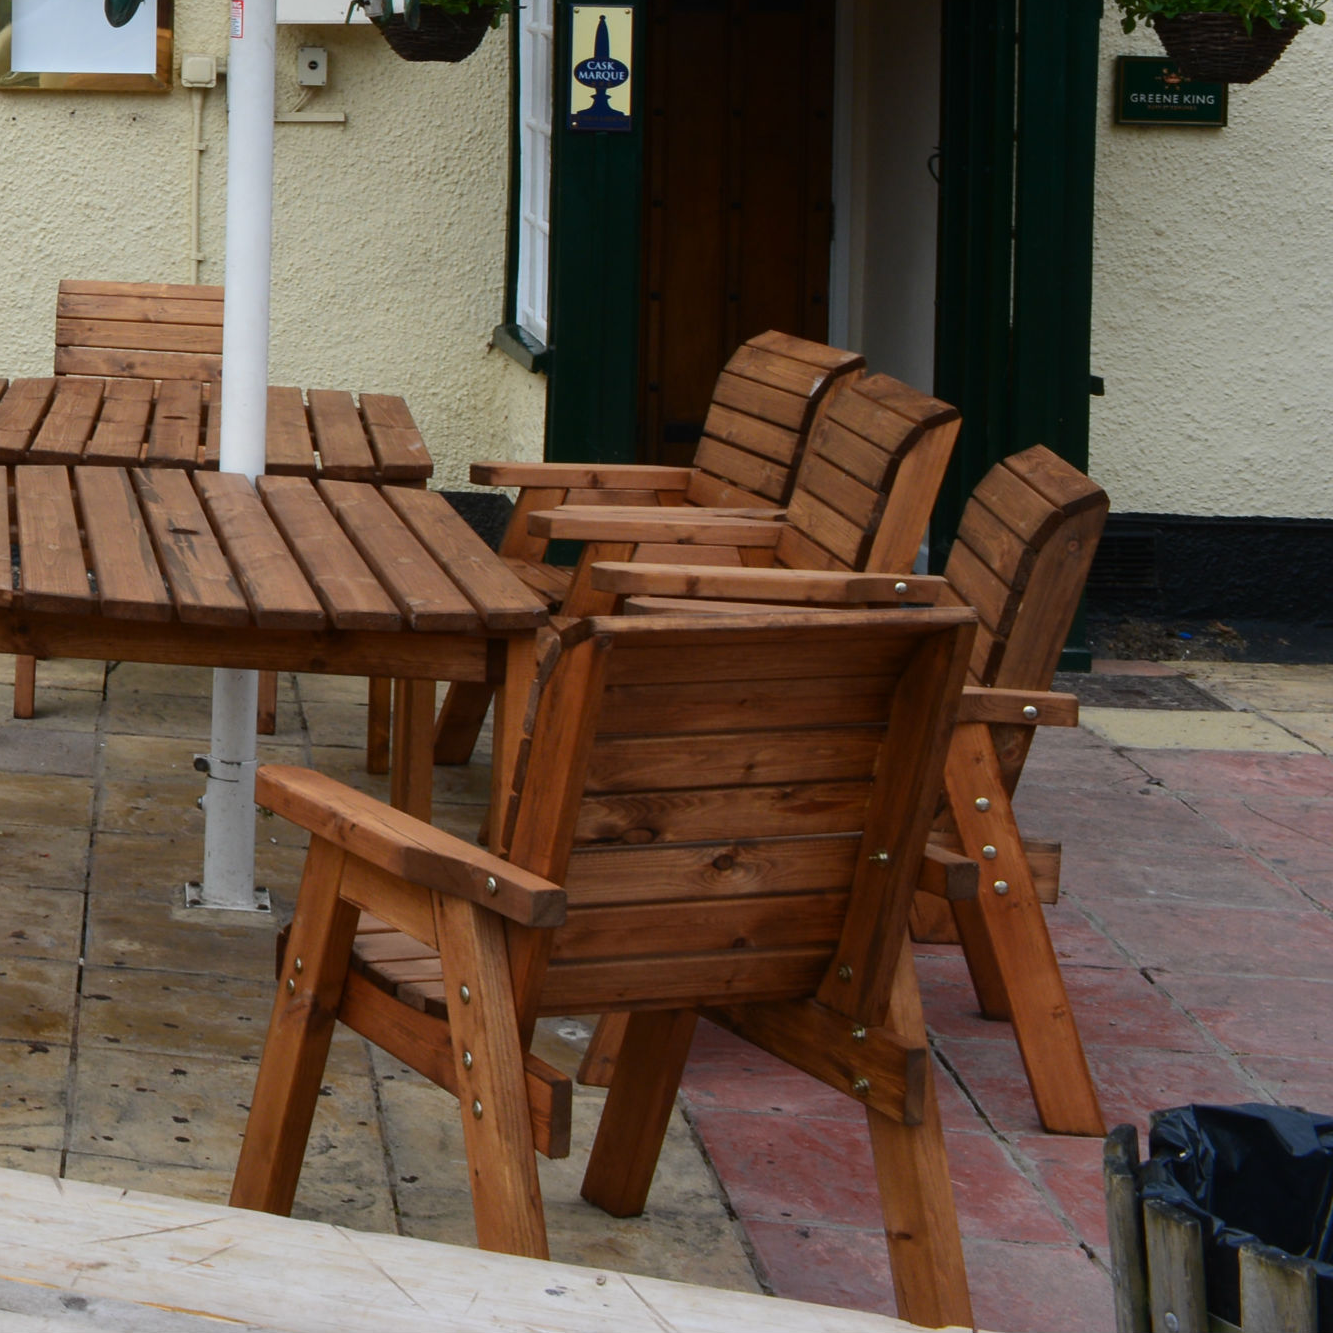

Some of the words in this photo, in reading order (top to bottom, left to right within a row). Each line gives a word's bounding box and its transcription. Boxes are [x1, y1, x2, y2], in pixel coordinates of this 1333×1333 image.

[586, 60, 616, 71] CASK
[578, 70, 626, 82] MARQUE
[1129, 93, 1180, 104] GREENE
[1182, 94, 1216, 105] KING
